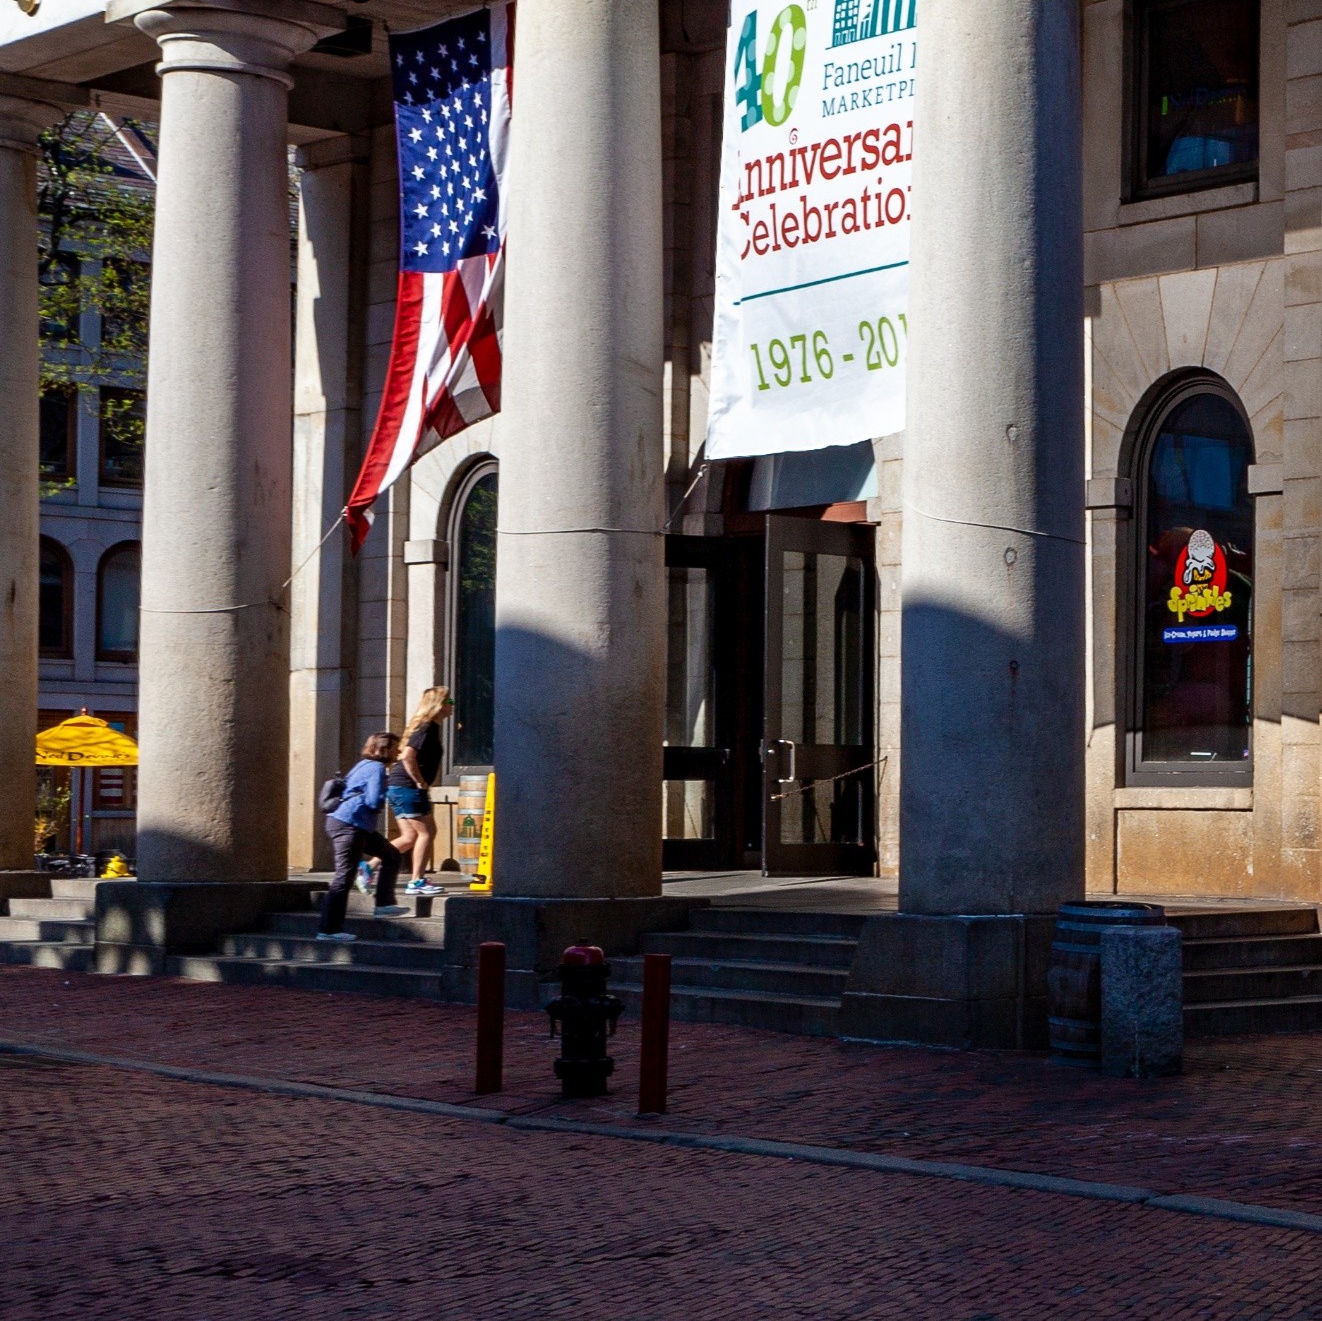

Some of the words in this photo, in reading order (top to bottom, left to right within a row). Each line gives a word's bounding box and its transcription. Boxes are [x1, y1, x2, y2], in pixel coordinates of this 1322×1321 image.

[822, 43, 903, 91] Faneuil
[733, 121, 913, 210] nniversa
[740, 177, 911, 260] elebratio
[750, 330, 834, 391] 1976
[1167, 584, 1232, 622] Sprinkles
